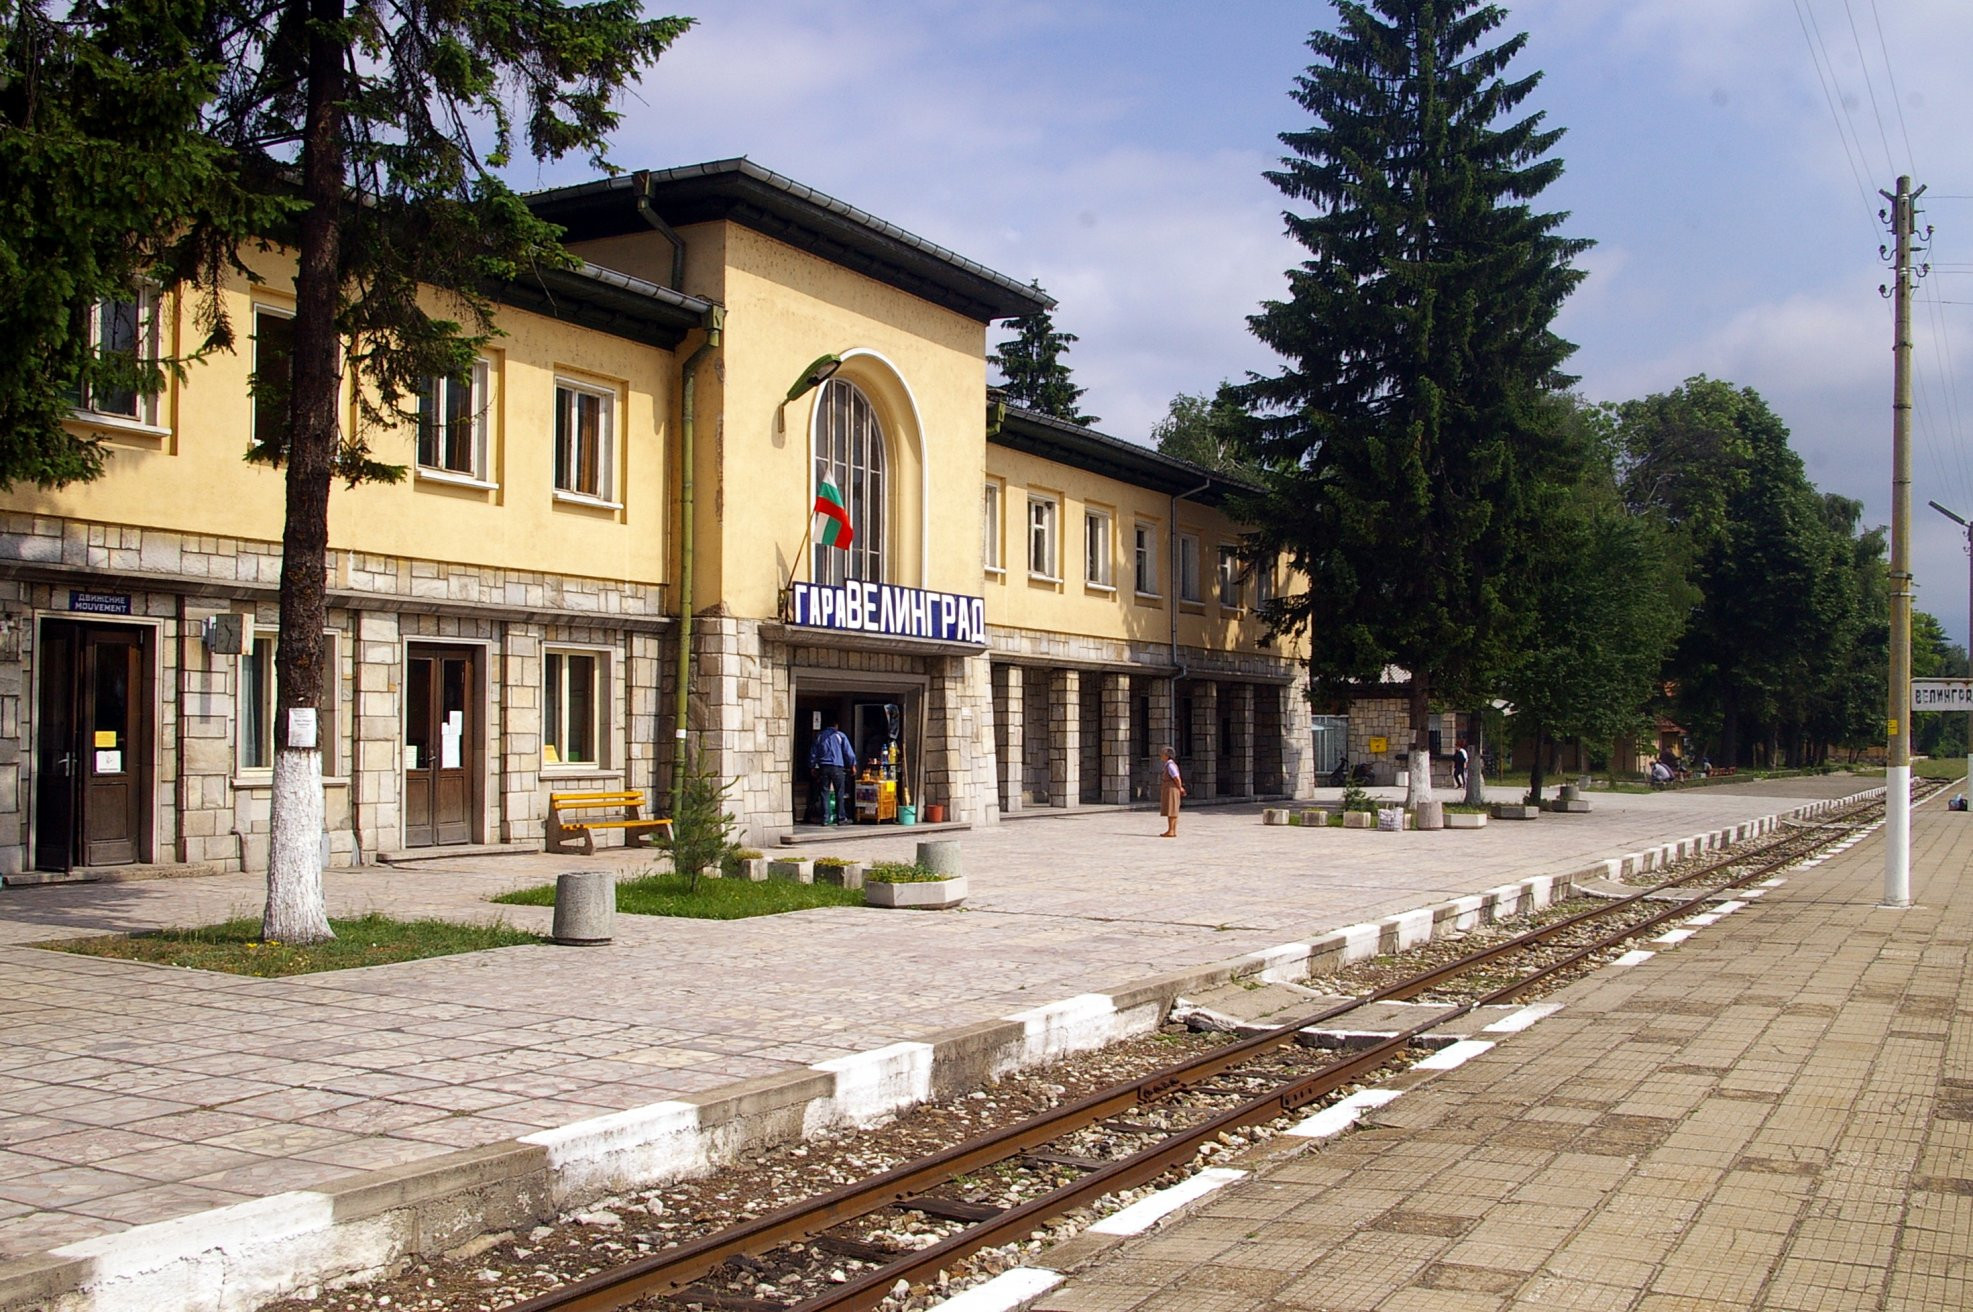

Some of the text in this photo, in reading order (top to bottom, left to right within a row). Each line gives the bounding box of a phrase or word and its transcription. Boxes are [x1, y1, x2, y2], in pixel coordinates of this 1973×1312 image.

[78, 593, 125, 604] ДВИЖЕНИЕ
[75, 602, 127, 613] MOUVEMENT
[794, 580, 985, 643] ГАРА ВЕЛИНГРАД
[1915, 688, 1973, 704] ВЕЛИНГРА
